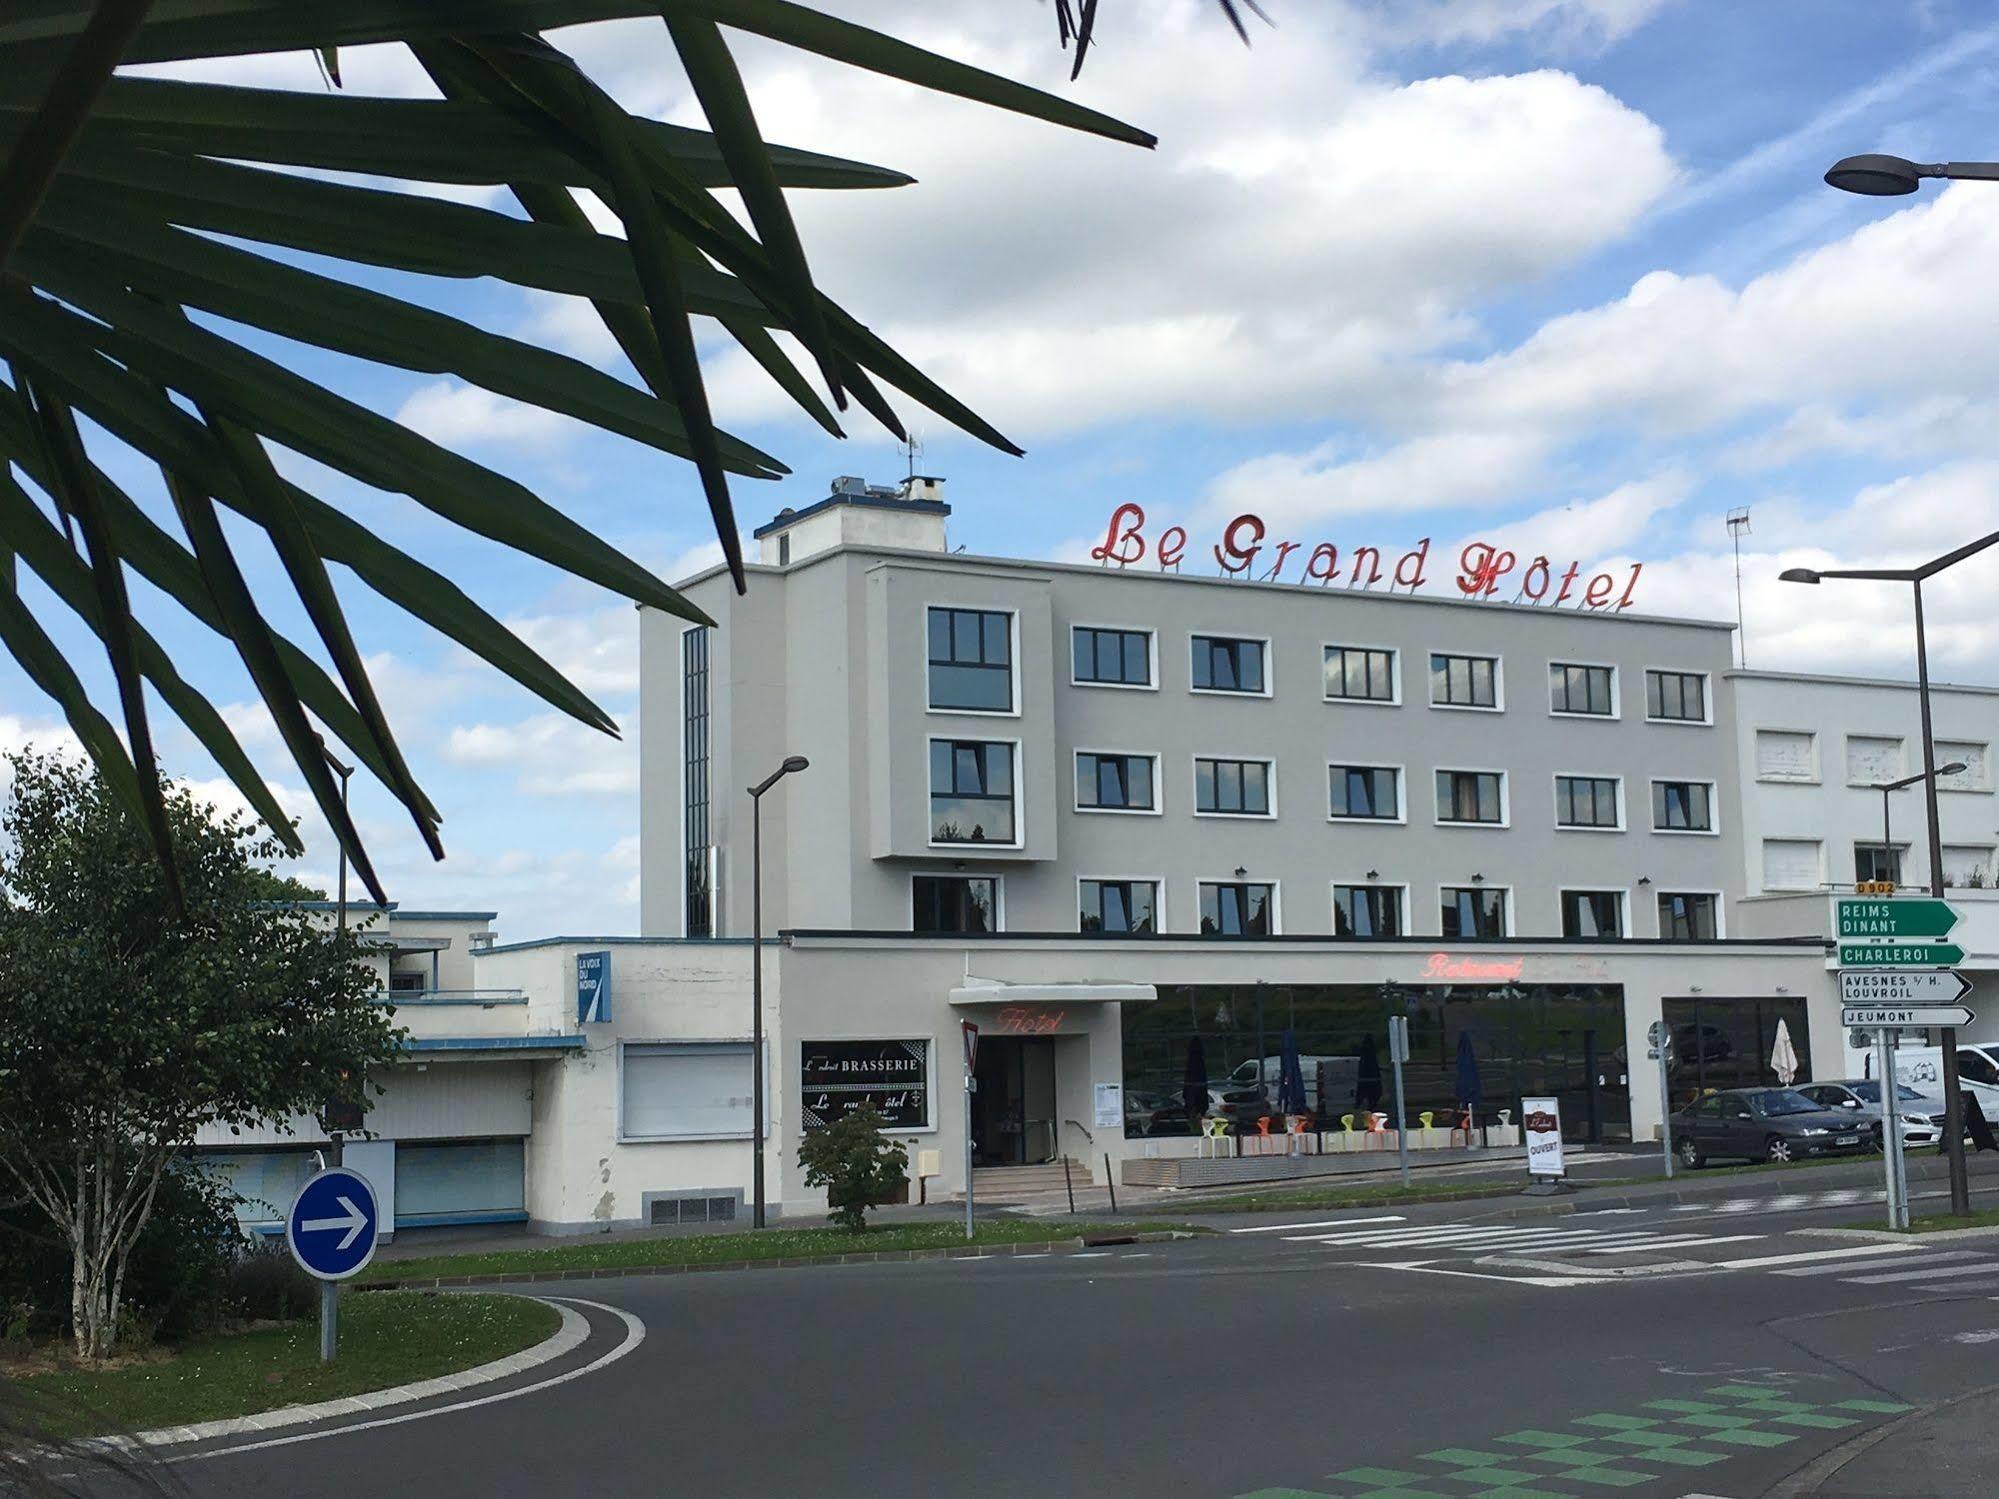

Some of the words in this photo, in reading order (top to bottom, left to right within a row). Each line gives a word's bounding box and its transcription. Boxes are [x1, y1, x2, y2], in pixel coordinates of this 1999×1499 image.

[1213, 514, 1431, 588] Grand
[1456, 542, 1643, 607] Hôtel
[1842, 905, 1890, 918] REIMS
[1843, 920, 1897, 932] DINANT
[1844, 949, 1928, 961] CHARLEROI
[579, 970, 588, 979] DU
[579, 980, 597, 989] NORD
[1846, 976, 1907, 986] AVESNES
[1846, 988, 1912, 998] LOUVROIL
[1848, 1012, 1913, 1021] JEUMONT
[842, 1059, 918, 1072] BRASSERIE
[811, 1094, 830, 1109] Le
[1530, 1142, 1557, 1155] OUVERT
